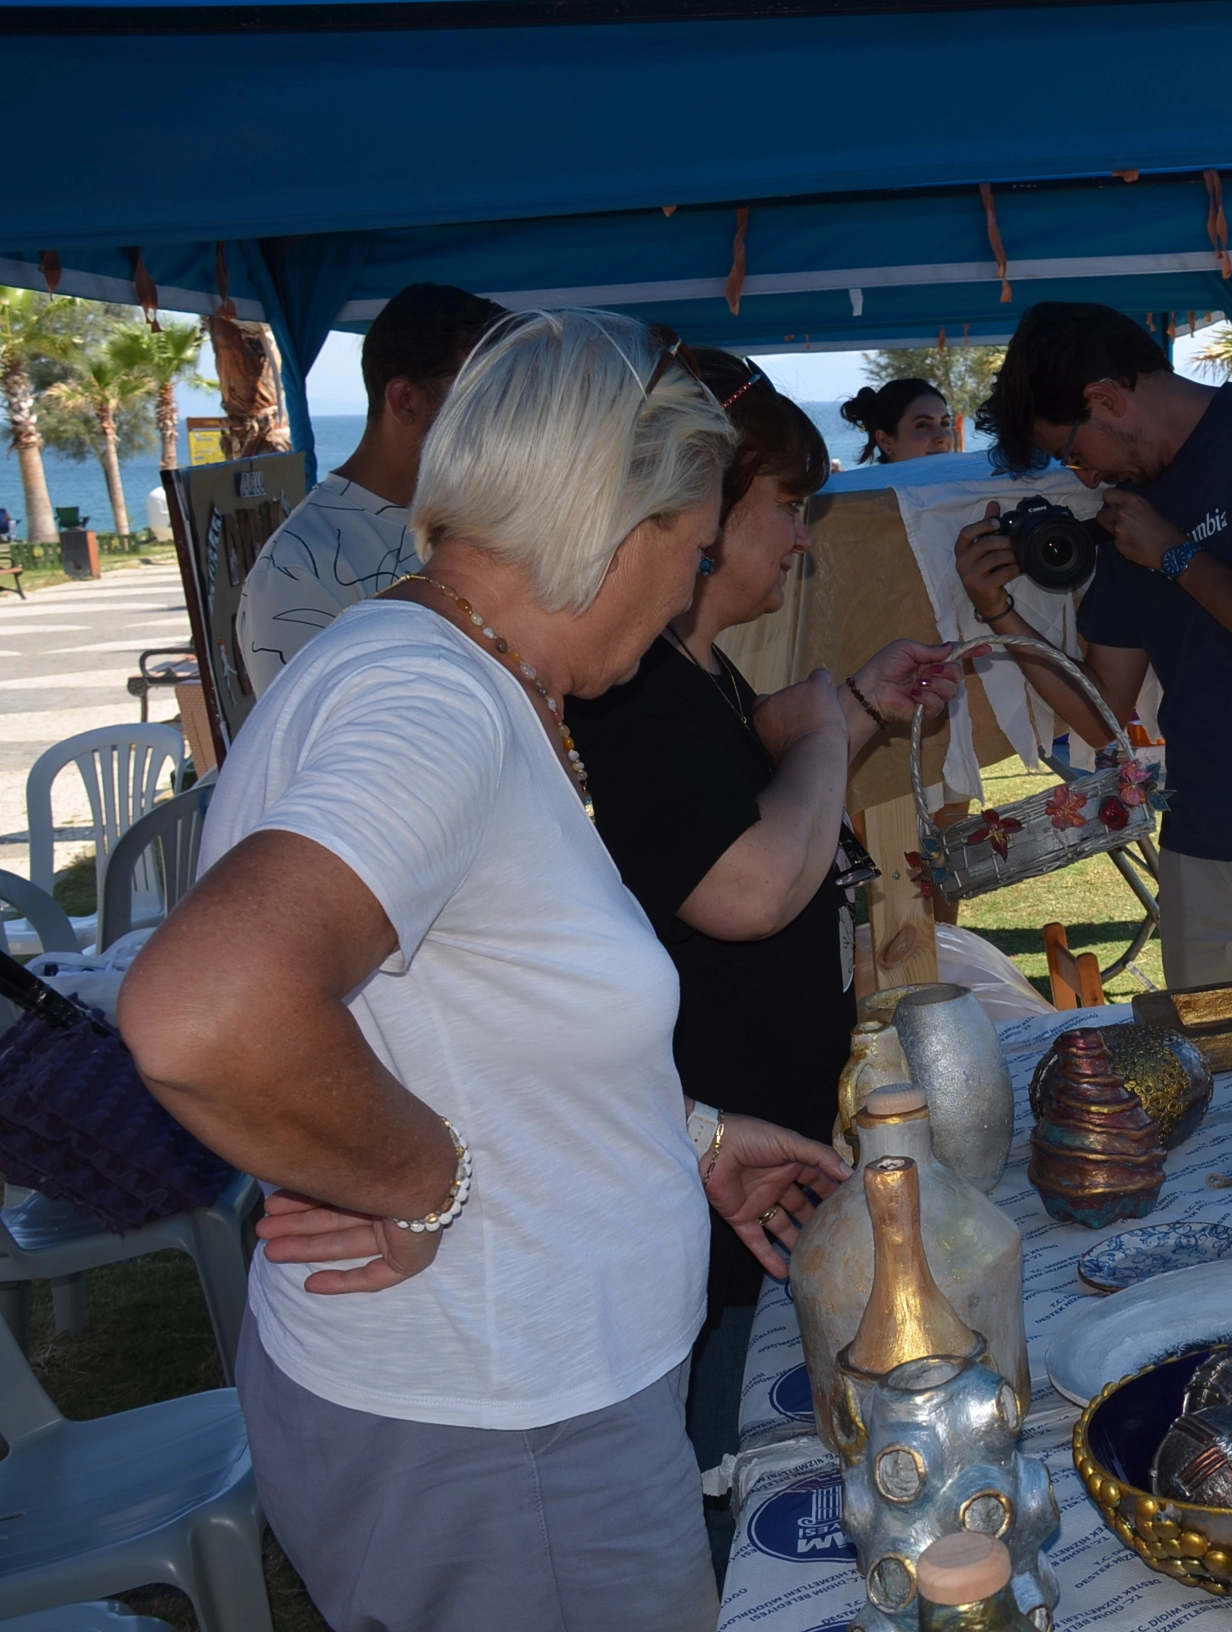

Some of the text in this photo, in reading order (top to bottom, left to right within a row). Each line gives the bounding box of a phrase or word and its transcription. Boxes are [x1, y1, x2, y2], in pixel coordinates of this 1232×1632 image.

[1028, 505, 1047, 513] Canon
[1089, 1523, 1109, 1538] TEK
[1074, 1563, 1114, 1589] DESTEK
[1060, 1578, 1162, 1624] DESTEK HİZMETLERİ
[1148, 1608, 1182, 1628] DİDİM
[1155, 1605, 1211, 1632] İZMETLERİ
